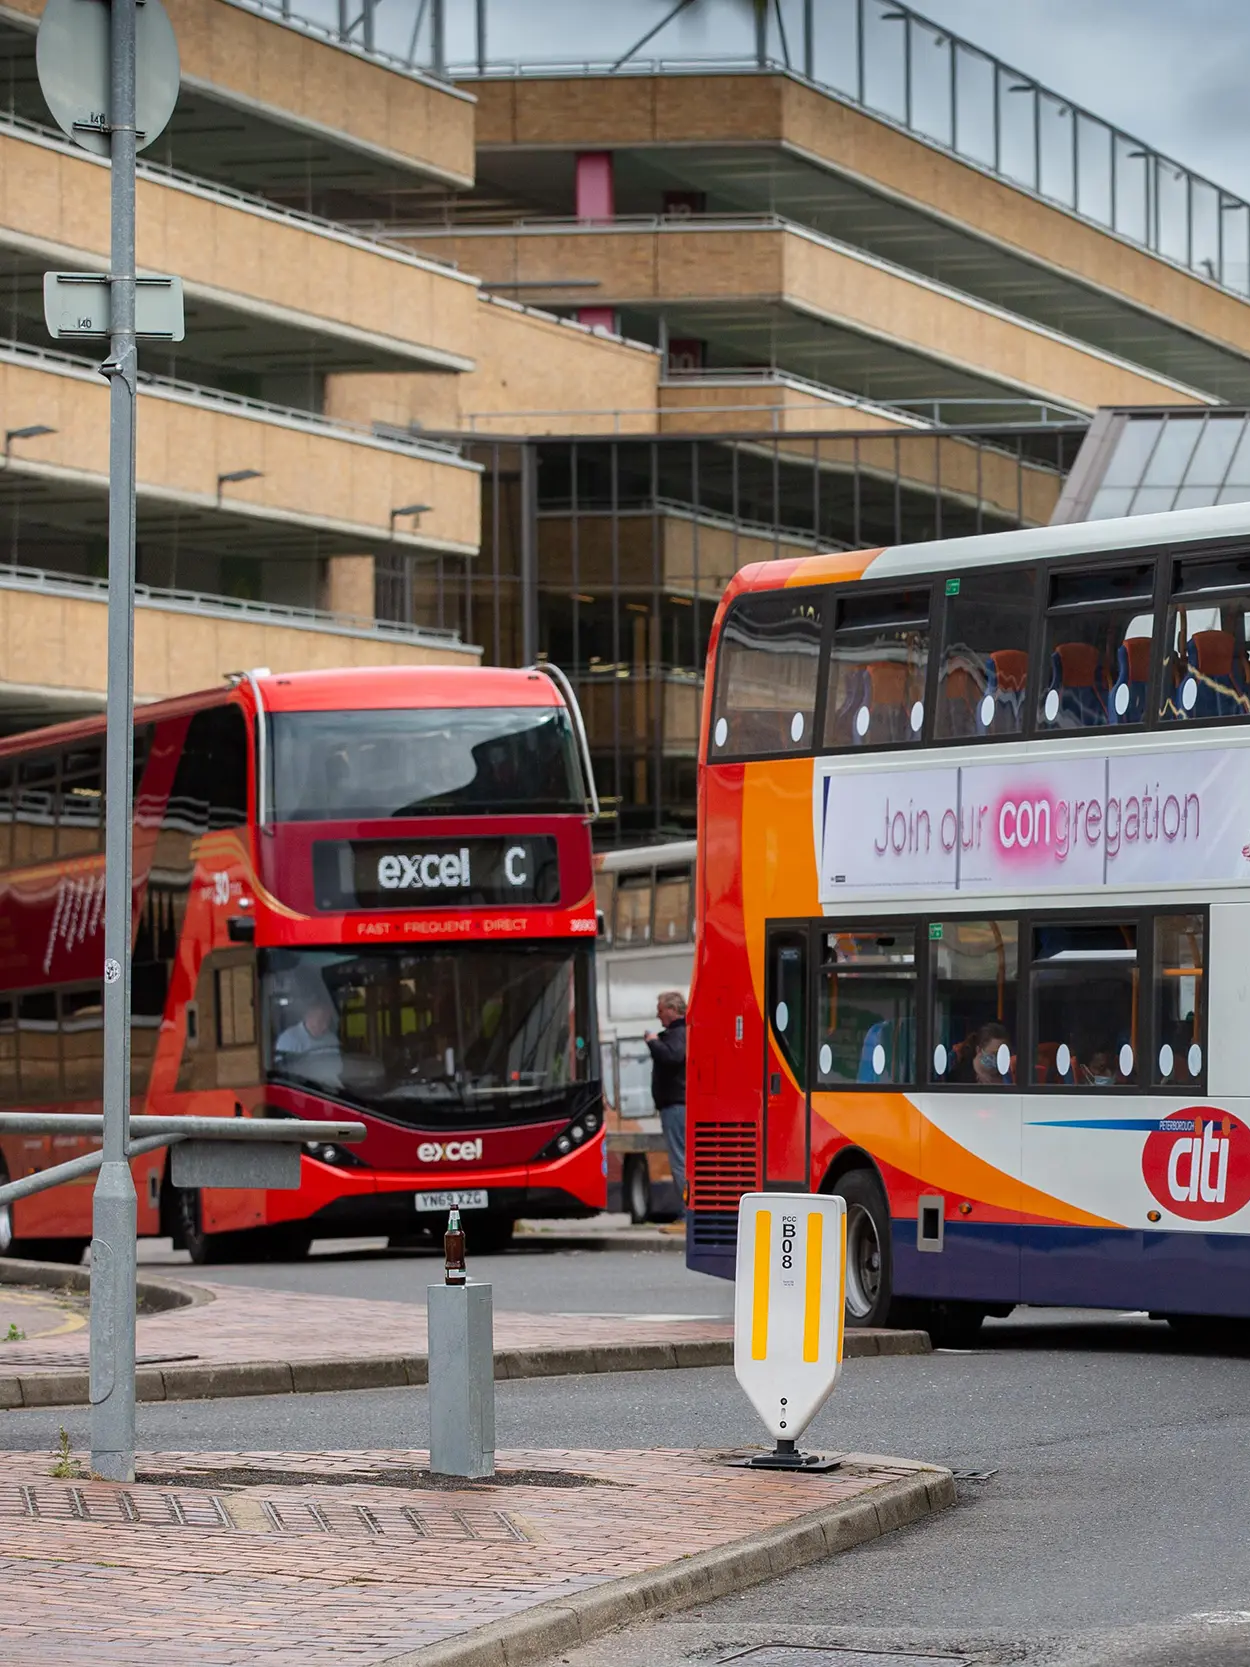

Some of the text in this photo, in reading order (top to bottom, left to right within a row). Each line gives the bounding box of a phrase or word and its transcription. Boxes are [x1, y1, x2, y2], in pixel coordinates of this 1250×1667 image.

[875, 782, 1200, 860] Join our congregation
[378, 847, 526, 888] excel C
[357, 918, 528, 936] FAST FREQUENT DIRECT
[1159, 1120, 1194, 1131] PETERBOROUGH
[416, 1138, 483, 1162] excel
[1168, 1116, 1230, 1203] citi
[422, 1194, 454, 1206] YN69
